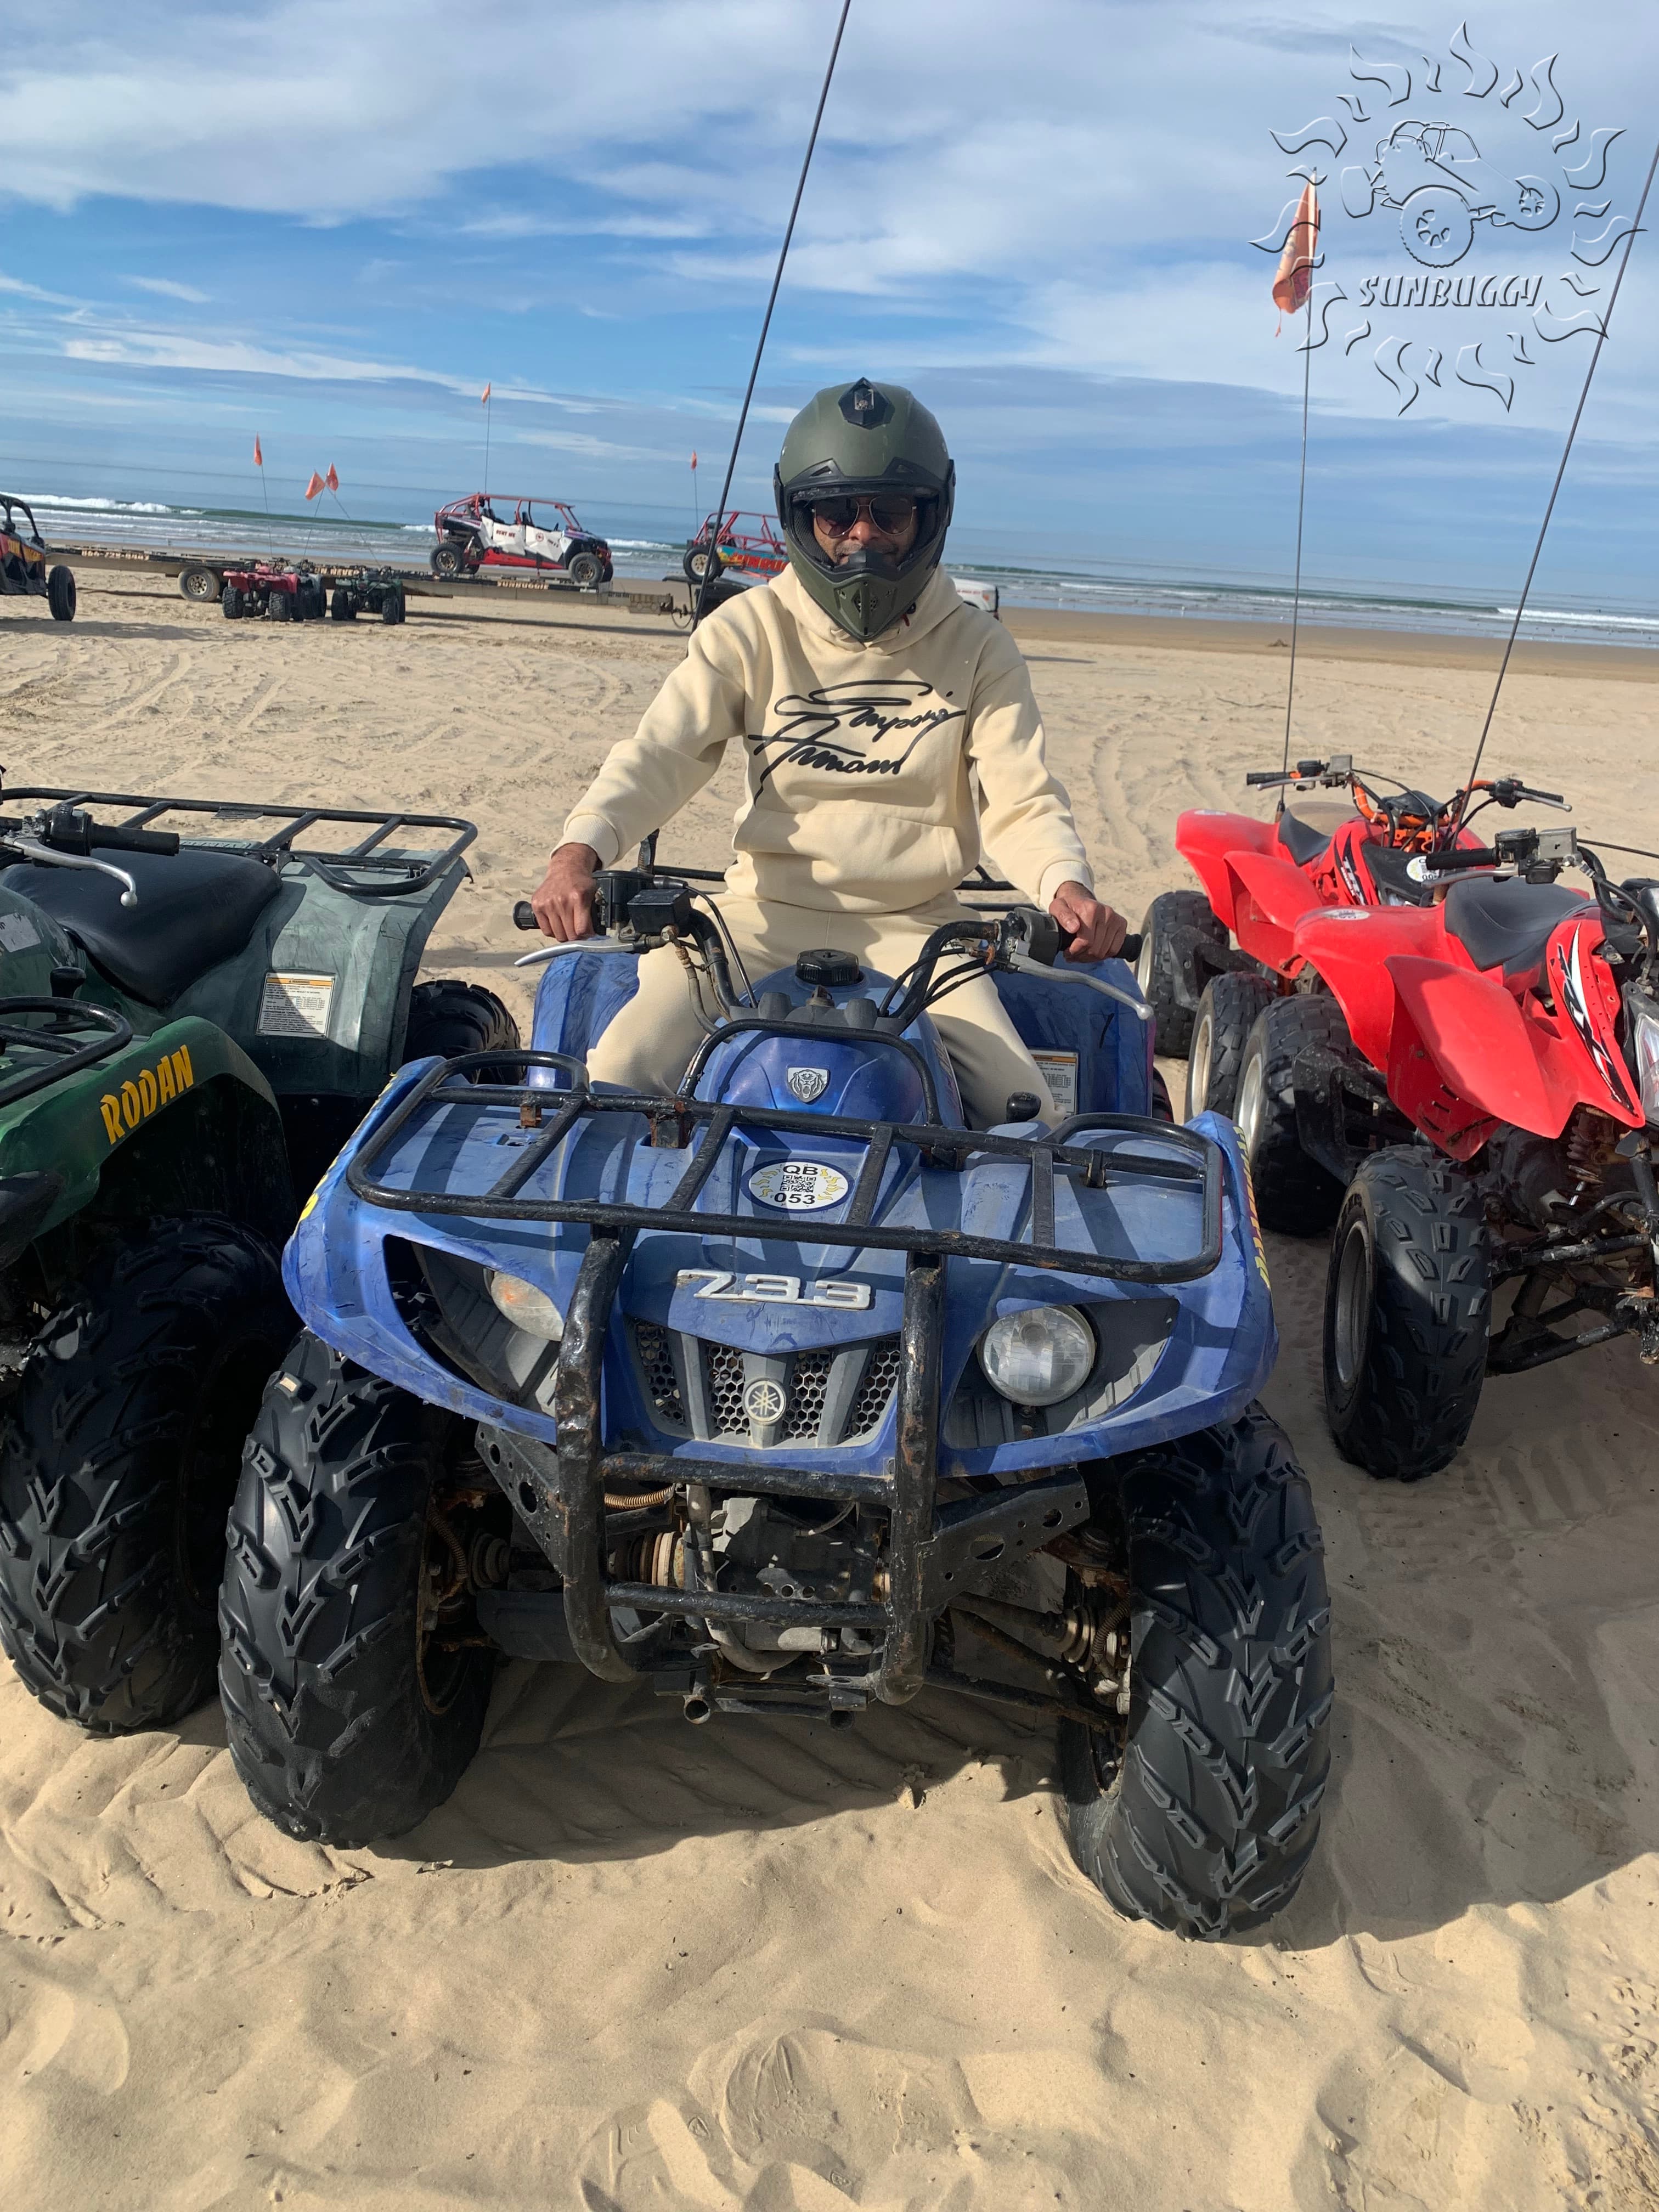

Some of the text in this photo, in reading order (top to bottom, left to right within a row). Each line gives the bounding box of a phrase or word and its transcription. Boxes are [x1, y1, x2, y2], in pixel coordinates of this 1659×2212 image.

[100, 1044, 194, 1145] RODAN
[783, 1165, 818, 1175] QB
[774, 1193, 815, 1204] 053
